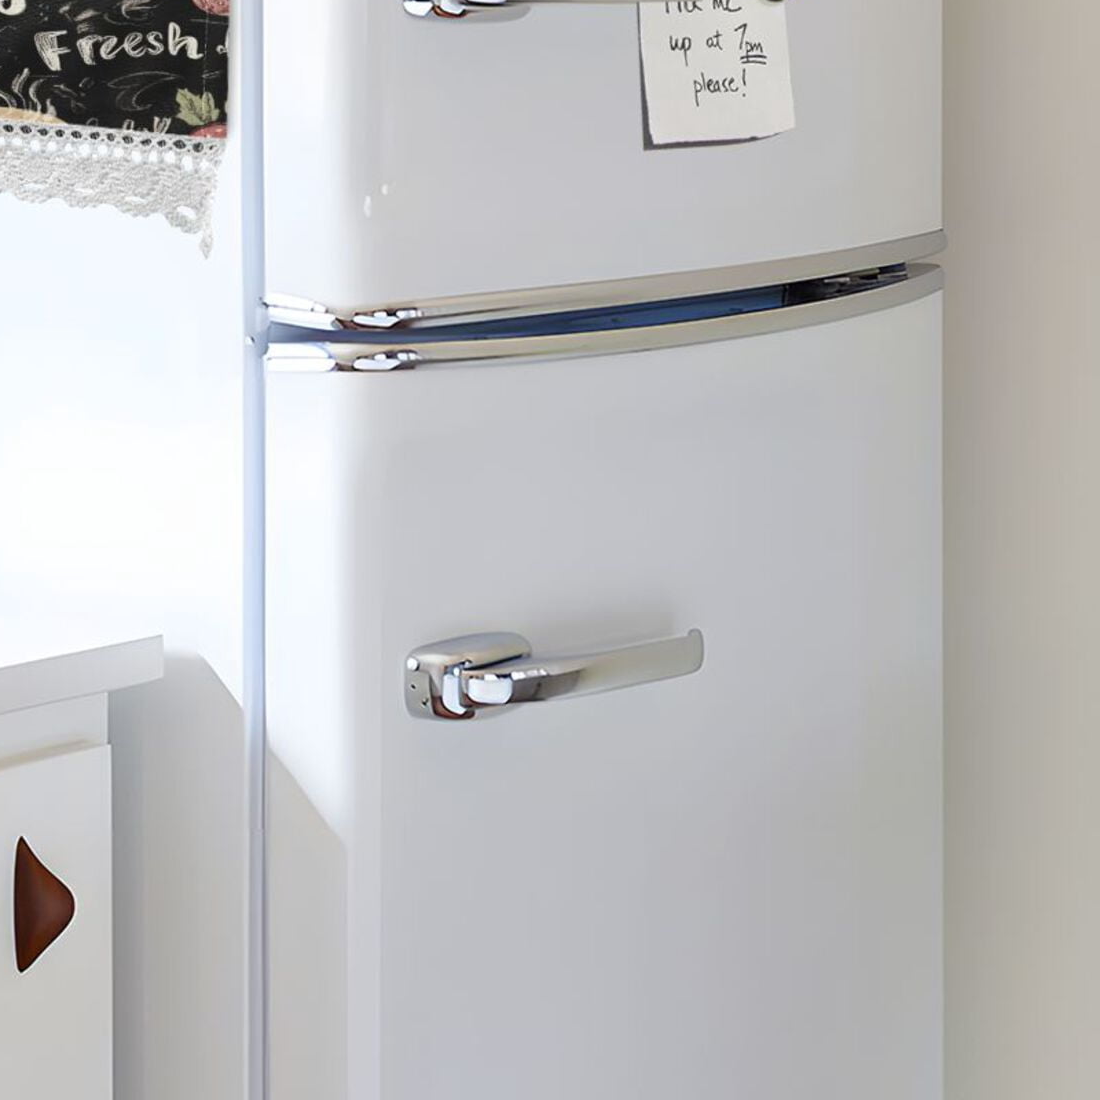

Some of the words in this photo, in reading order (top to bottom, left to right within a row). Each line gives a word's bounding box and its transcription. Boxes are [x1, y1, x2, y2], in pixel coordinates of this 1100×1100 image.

[669, 34, 692, 67] up
[705, 29, 724, 51] at
[693, 68, 747, 108] please!
